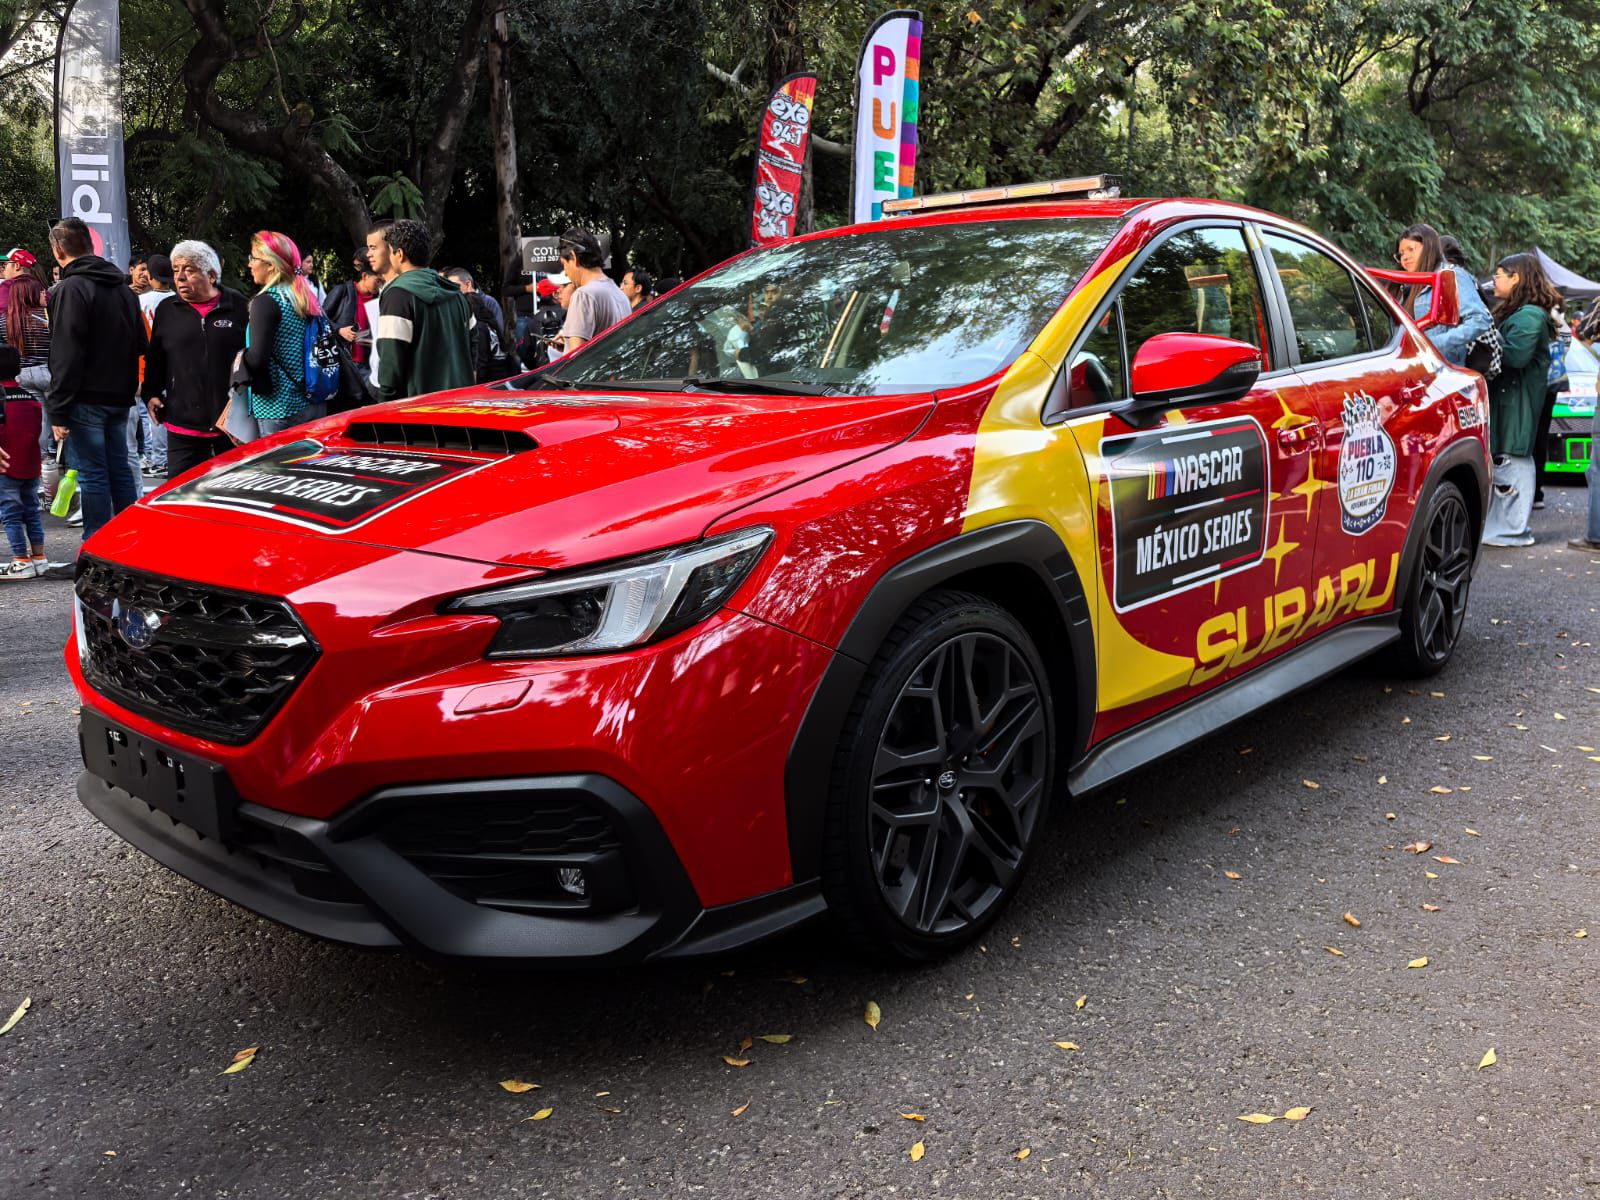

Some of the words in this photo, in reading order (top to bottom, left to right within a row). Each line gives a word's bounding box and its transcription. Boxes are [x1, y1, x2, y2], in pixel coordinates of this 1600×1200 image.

[769, 98, 809, 126] exa
[757, 185, 794, 215] exa
[1348, 435, 1384, 461] PUEBLA
[309, 454, 442, 475] NASCAR
[1173, 446, 1243, 495] NASCAR
[1356, 457, 1375, 482] 110
[271, 476, 382, 506] SERIES
[1136, 523, 1200, 575] MÉXICO
[1203, 508, 1253, 554] SERIES
[1189, 552, 1400, 686] SUBARU
